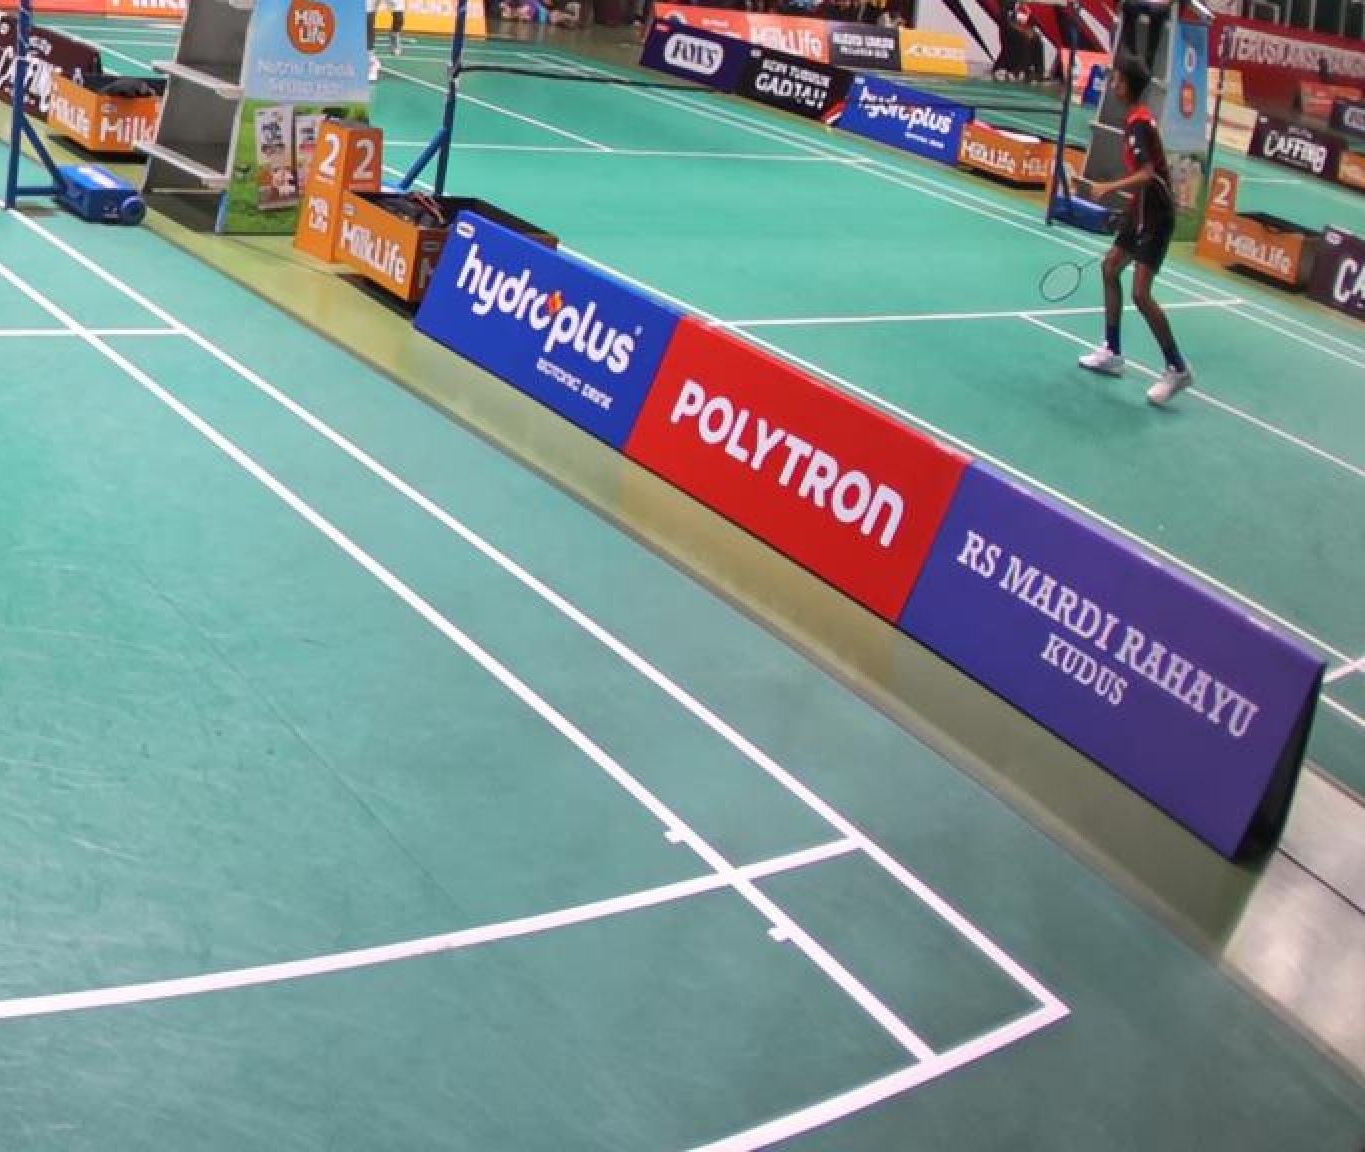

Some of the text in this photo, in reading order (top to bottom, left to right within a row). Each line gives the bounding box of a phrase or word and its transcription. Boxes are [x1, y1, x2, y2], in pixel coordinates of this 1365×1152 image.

[318, 133, 342, 178] 2
[352, 139, 375, 180] 2
[1213, 177, 1232, 207] 2
[340, 219, 406, 284] MilkLife
[456, 243, 636, 375] hydroplus
[670, 378, 904, 547] POLYTRON
[956, 529, 1261, 738] RS MARDI RAHAYU
[1040, 633, 1130, 706] KUDUS
